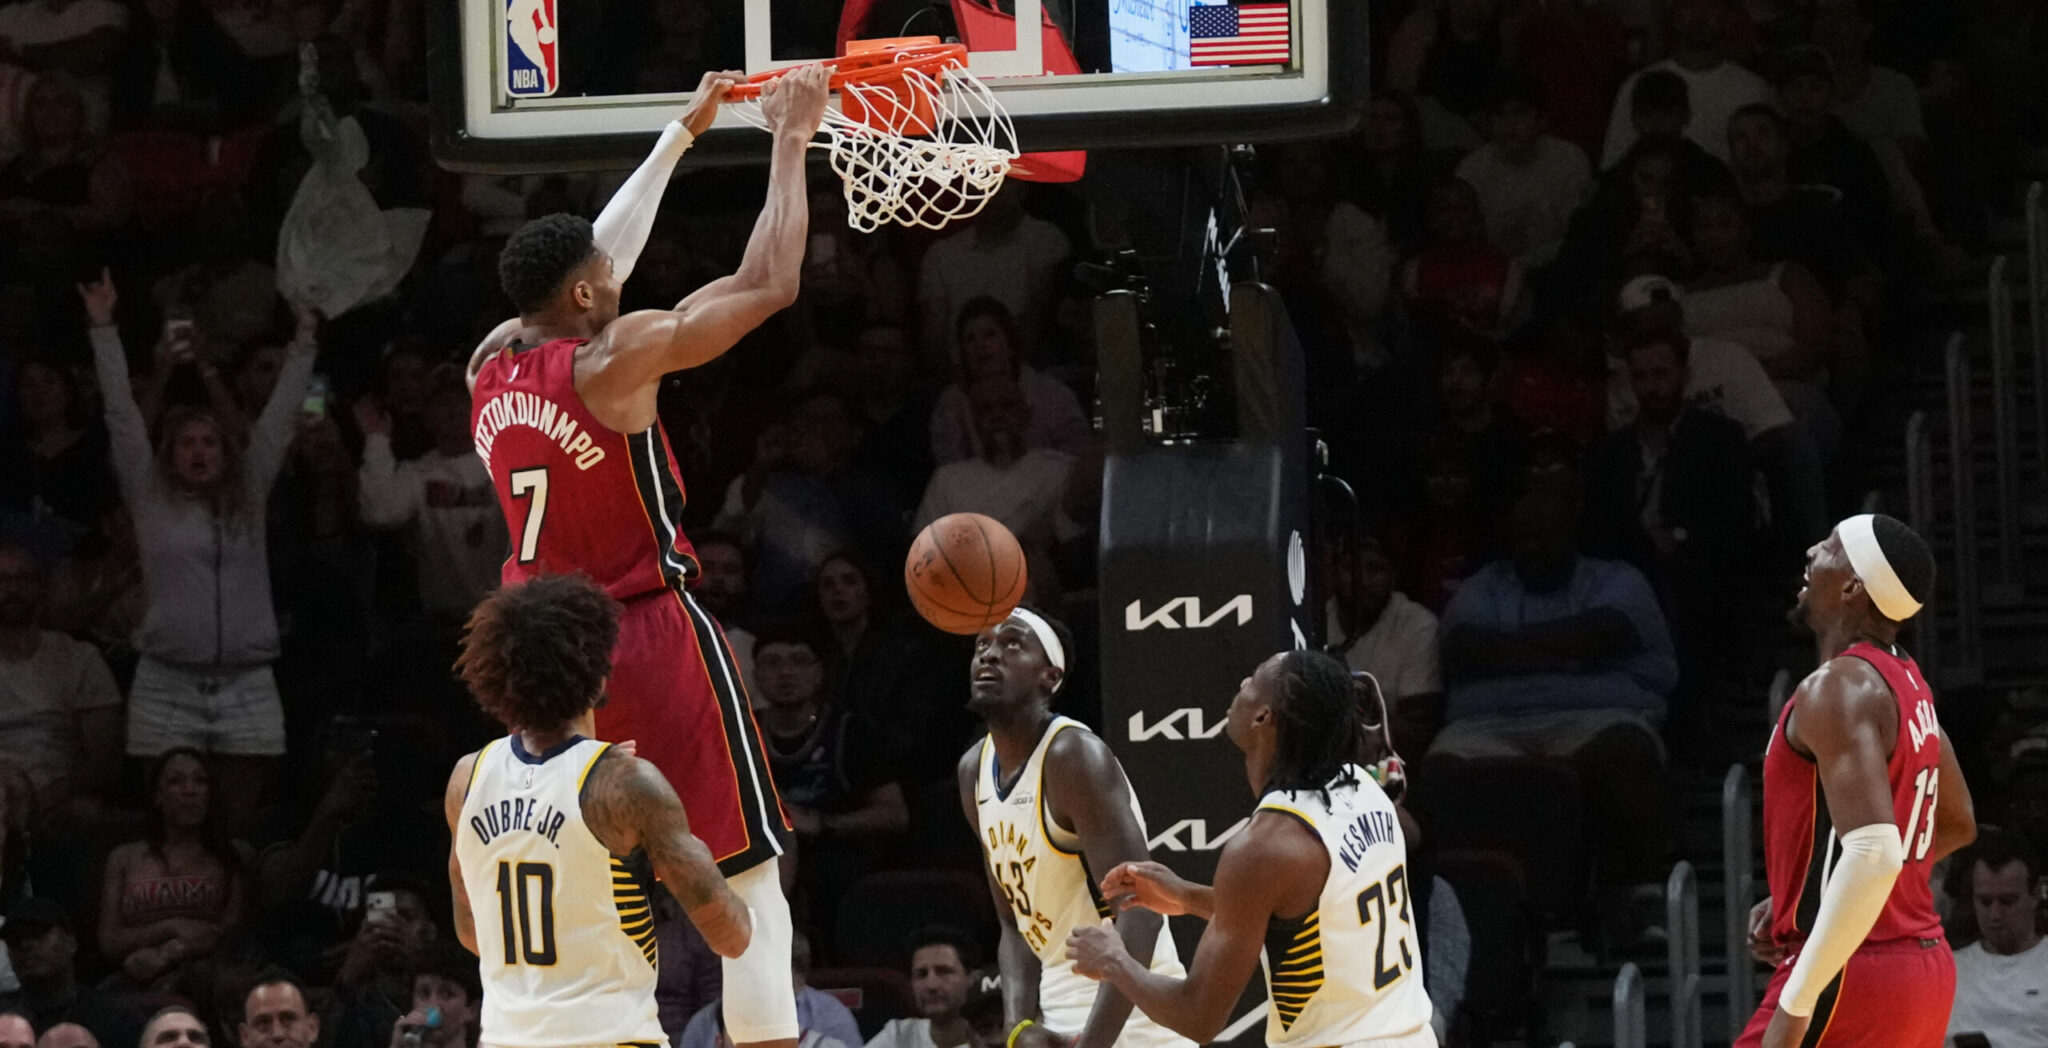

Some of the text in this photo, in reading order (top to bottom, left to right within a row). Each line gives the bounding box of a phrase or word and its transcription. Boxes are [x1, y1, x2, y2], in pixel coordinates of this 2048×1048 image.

[512, 69, 539, 88] NBA
[474, 391, 606, 482] NTETOKOUNMPO
[510, 465, 548, 565] 7
[1126, 594, 1252, 630] KIA
[1129, 708, 1229, 741] KI
[471, 798, 565, 848] OUBRE JR.
[1339, 811, 1394, 873] NESMITH
[1901, 767, 1939, 860] 13
[988, 821, 1036, 873] DIANA
[496, 861, 558, 967] 10
[1356, 863, 1412, 992] 23
